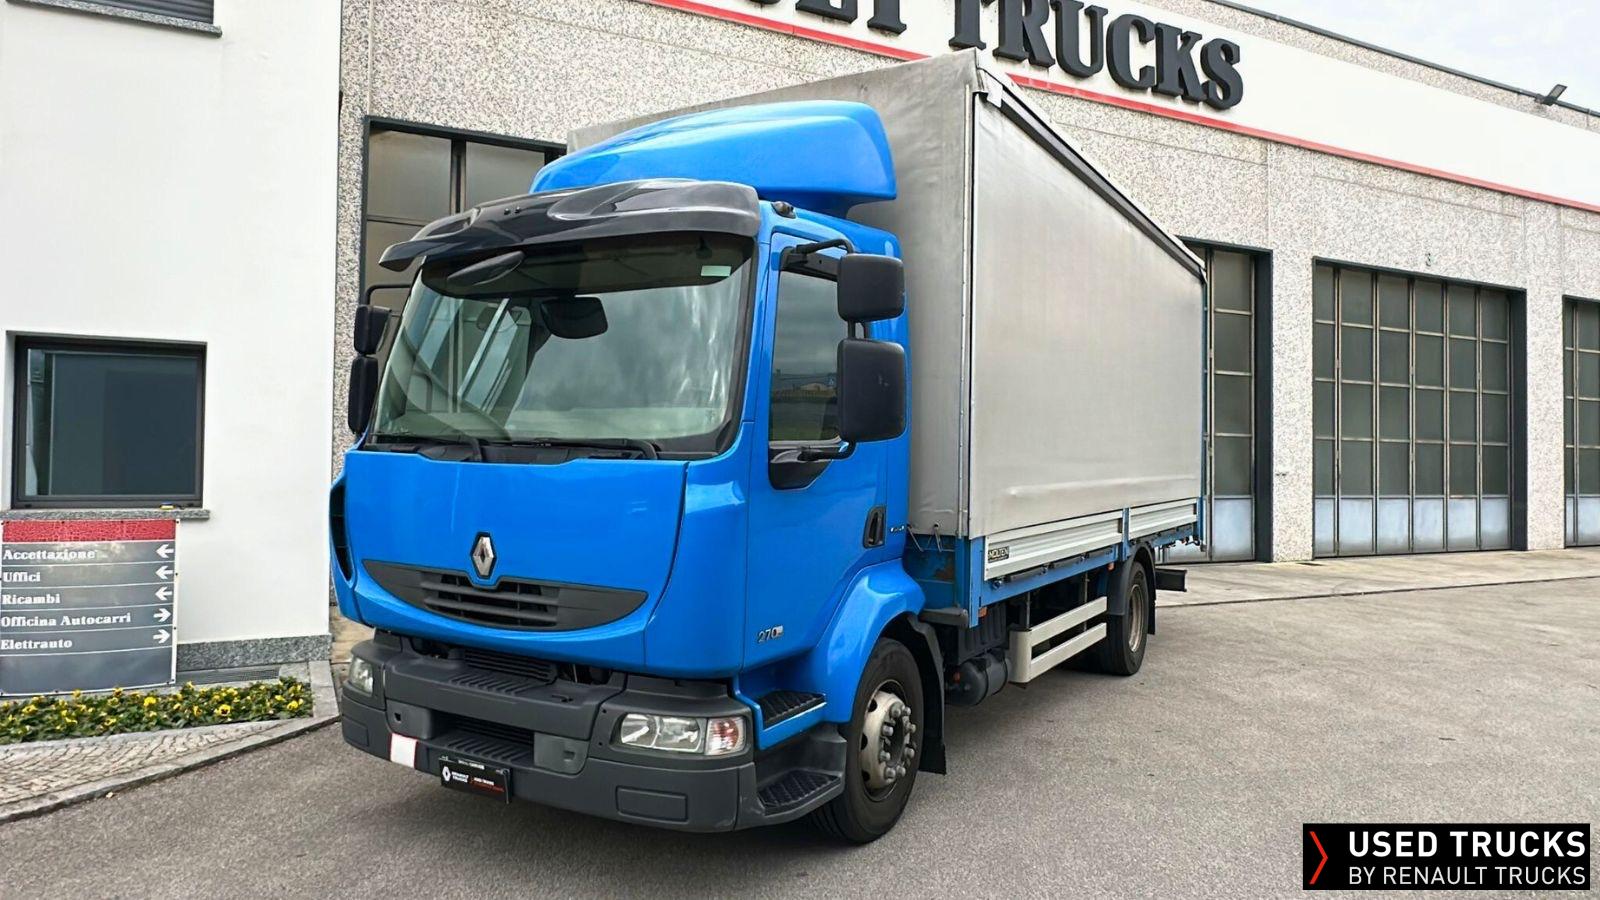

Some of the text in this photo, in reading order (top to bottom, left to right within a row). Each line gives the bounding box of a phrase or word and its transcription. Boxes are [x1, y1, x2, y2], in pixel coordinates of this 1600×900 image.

[949, 0, 1243, 110] TRUCKS
[3, 549, 96, 561] Accettazione
[3, 571, 41, 582] Uffici
[2, 594, 61, 605] Ricambi
[1, 612, 131, 627] Officina Autocarri
[758, 627, 777, 643] 270
[0, 639, 73, 650] Elettrauto
